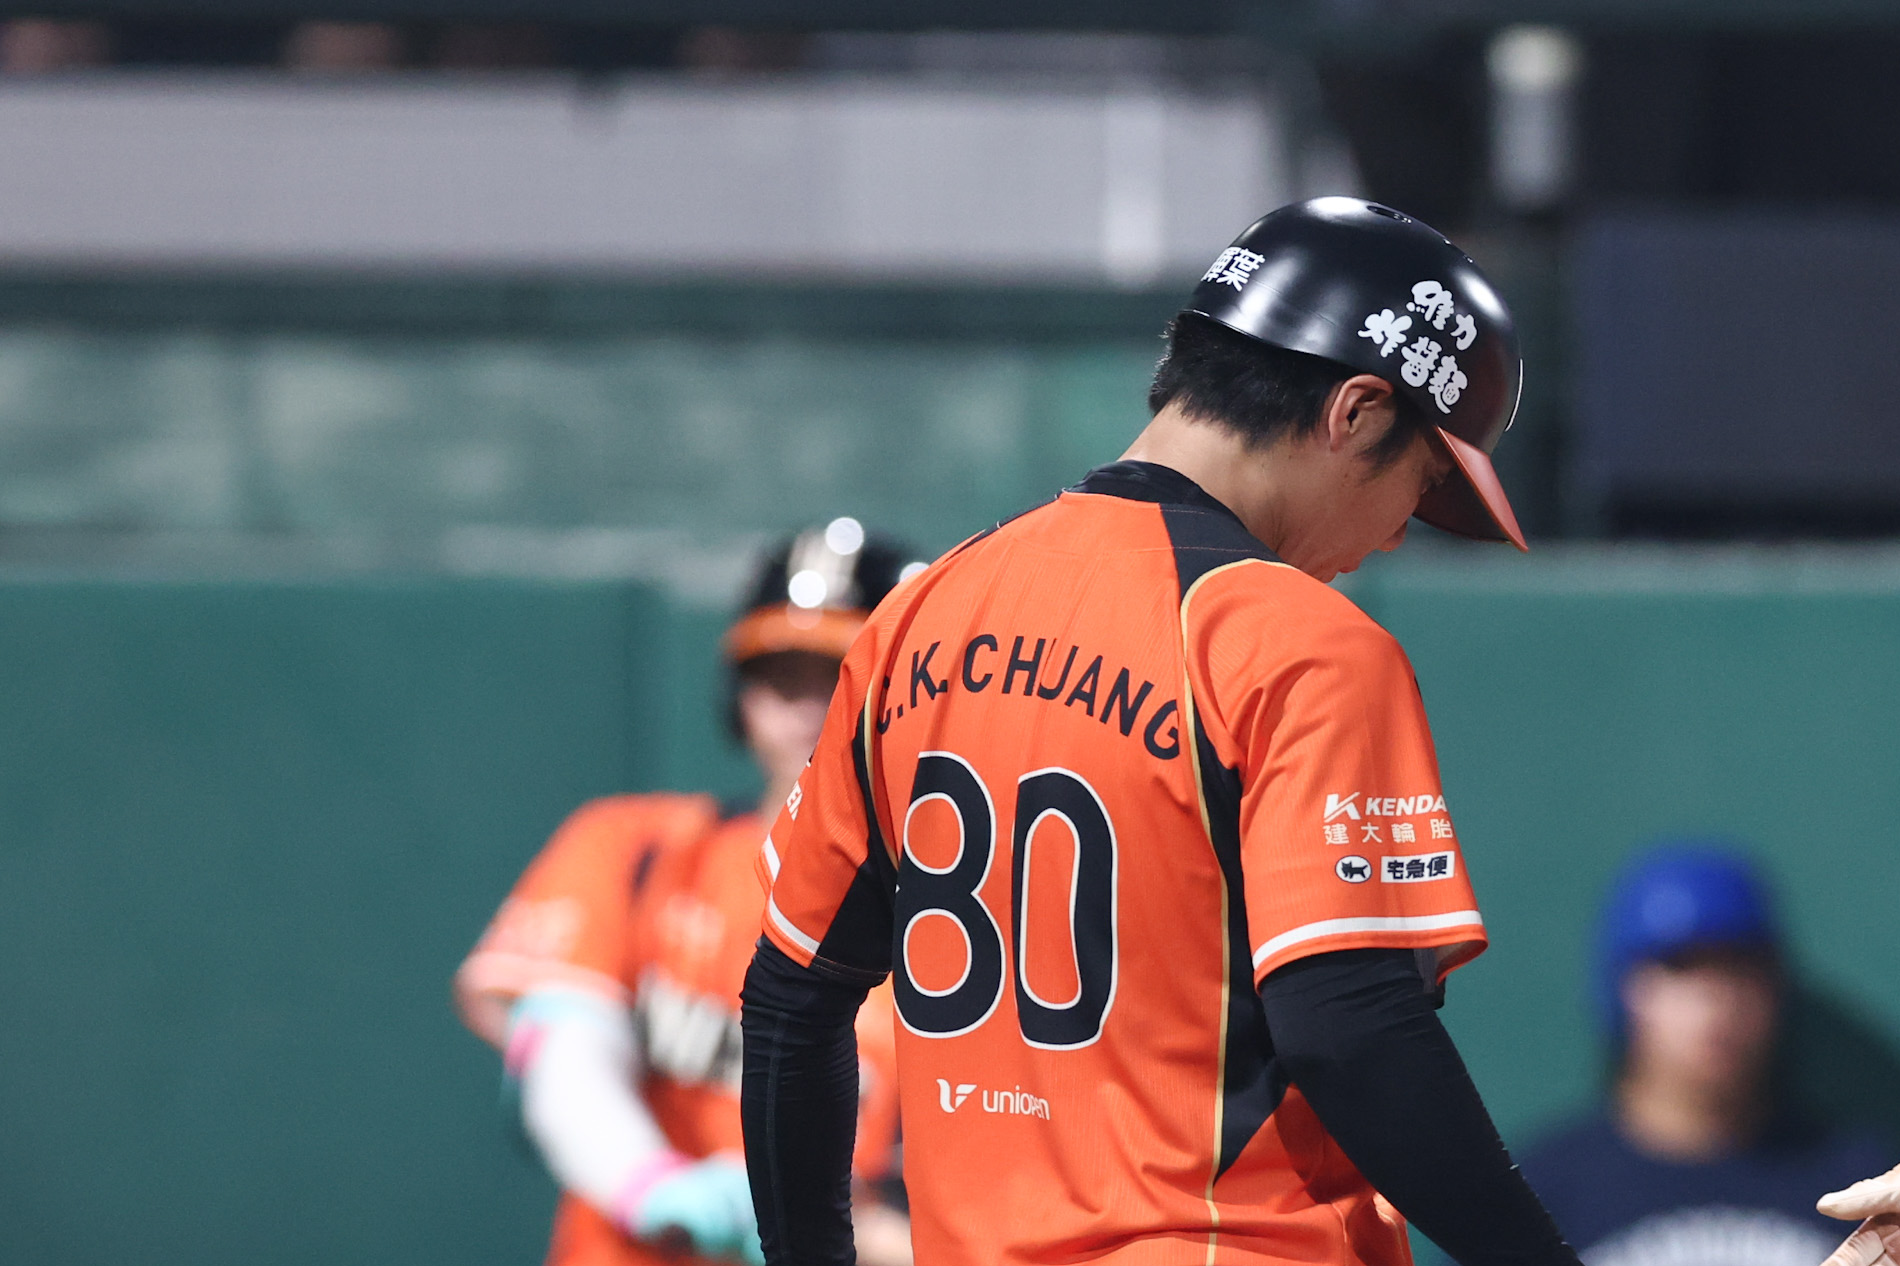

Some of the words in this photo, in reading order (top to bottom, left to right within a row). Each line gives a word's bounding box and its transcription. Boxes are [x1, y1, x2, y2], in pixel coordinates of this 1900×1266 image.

[1364, 794, 1449, 817] KENDA
[1322, 818, 1454, 845] 建大輪胎
[1386, 855, 1449, 880] 宅急便
[892, 750, 1118, 1051] 80
